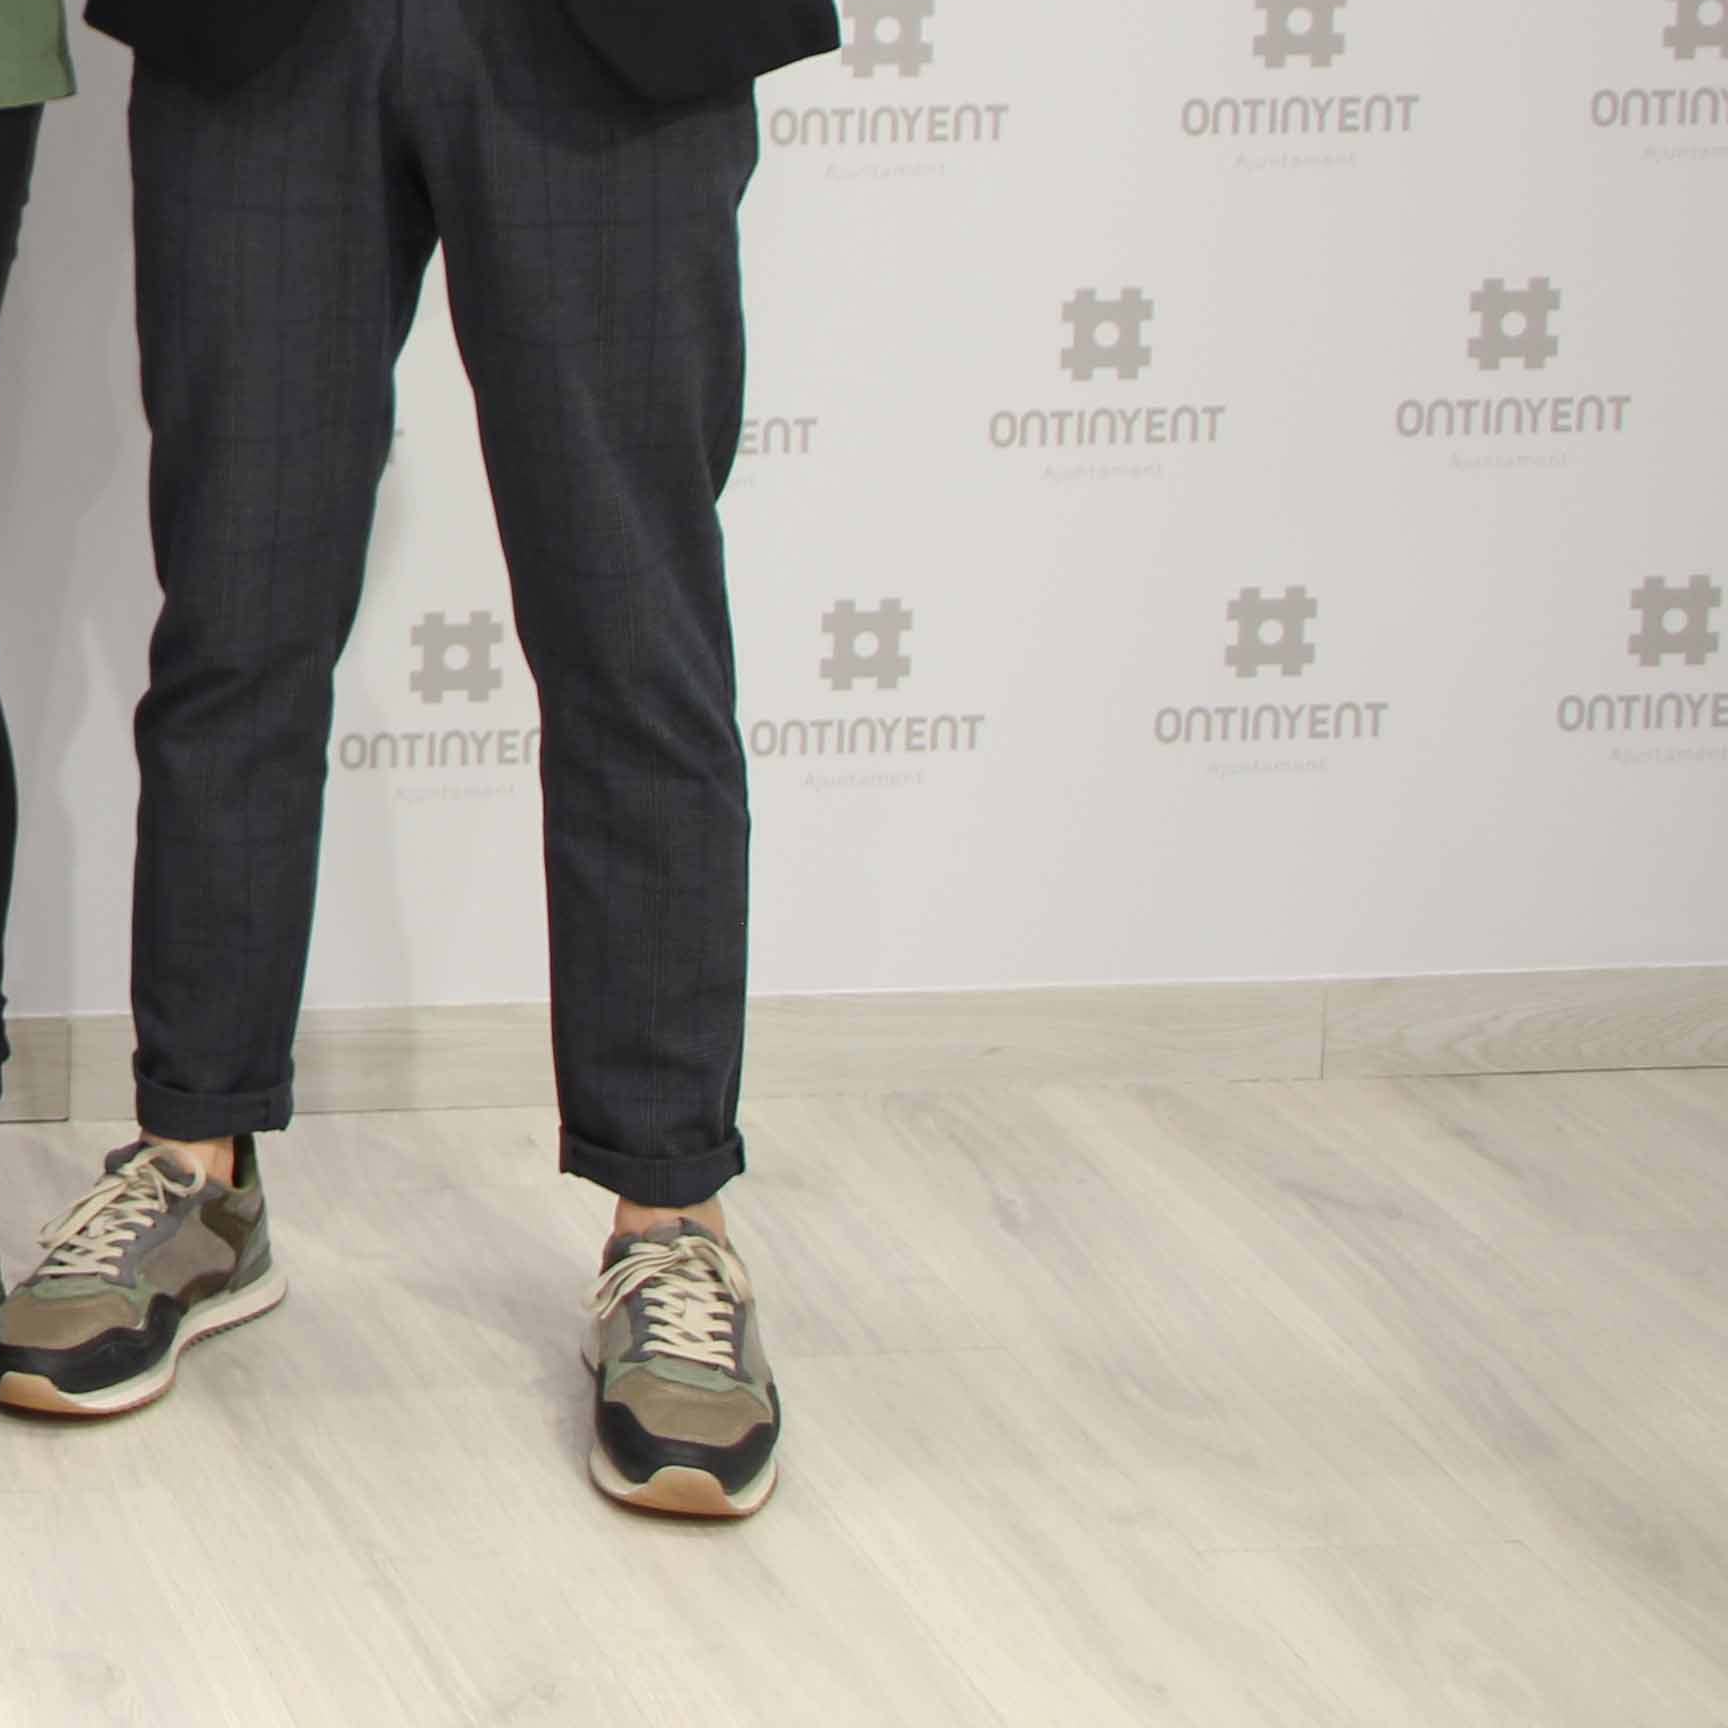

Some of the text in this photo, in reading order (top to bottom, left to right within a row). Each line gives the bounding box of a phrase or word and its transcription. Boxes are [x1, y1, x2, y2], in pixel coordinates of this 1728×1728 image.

[772, 104, 1009, 145] ONTINYENT
[1181, 94, 1420, 137] ONTINYENT
[989, 405, 1225, 448] ONTINYENT
[1396, 395, 1631, 437] ONTINYENT
[751, 715, 985, 757] ONTINYENT
[1154, 701, 1389, 744] ONTINYENT
